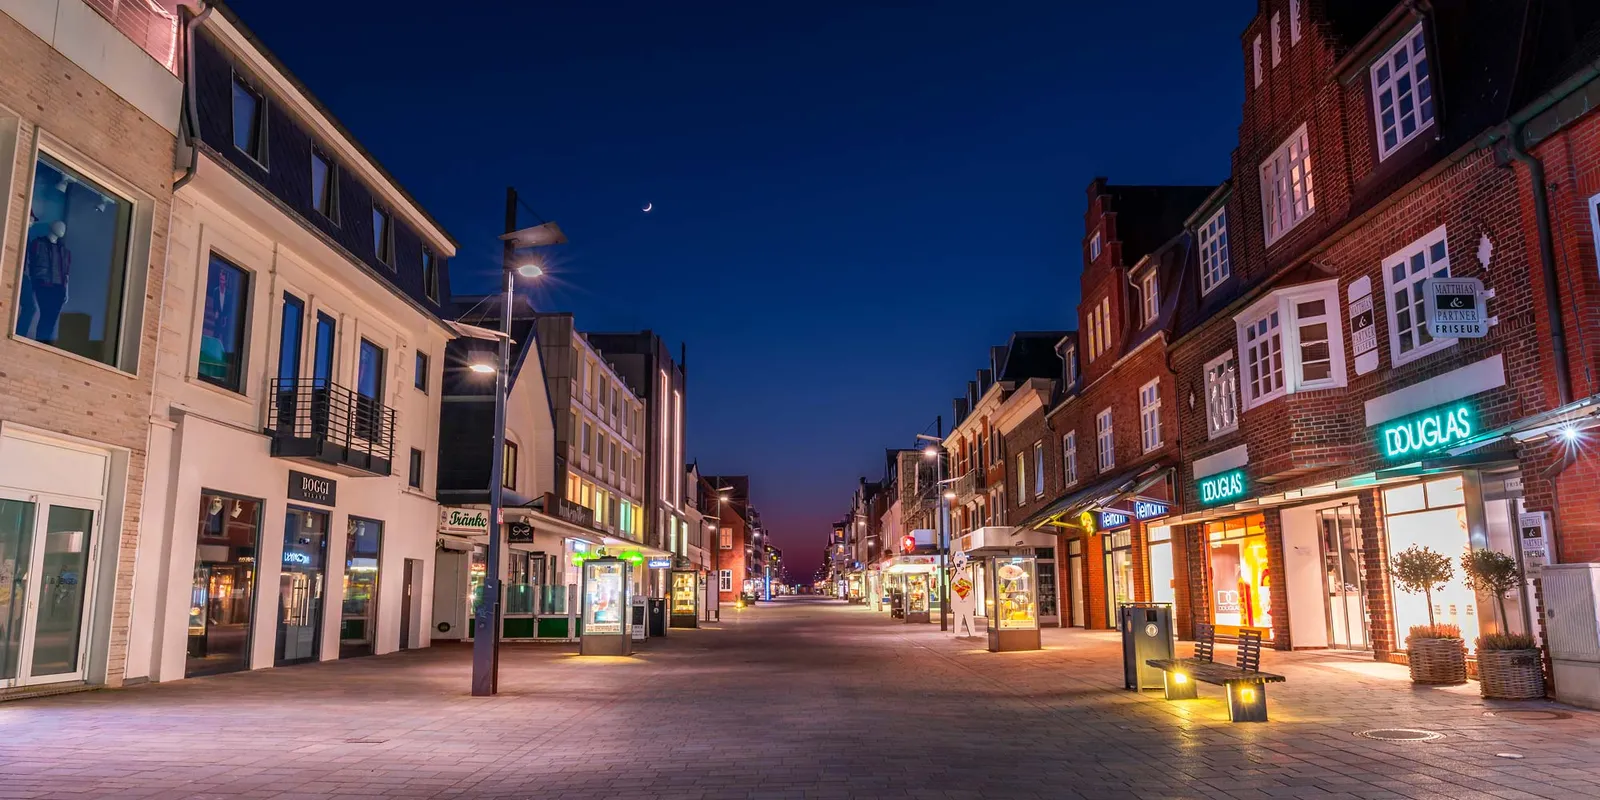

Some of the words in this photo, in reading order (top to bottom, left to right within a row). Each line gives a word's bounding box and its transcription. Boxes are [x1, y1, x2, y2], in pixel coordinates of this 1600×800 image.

[1435, 284, 1474, 294] MATTHIAS
[1450, 297, 1464, 308] &
[1358, 315, 1368, 328] &
[1437, 310, 1477, 321] PARTNER
[1435, 324, 1480, 333] FRISEUR
[1385, 407, 1471, 456] DOUGLAS
[302, 476, 329, 495] BOGGI
[1202, 472, 1242, 502] DOUGLAS
[449, 510, 488, 527] Tränke
